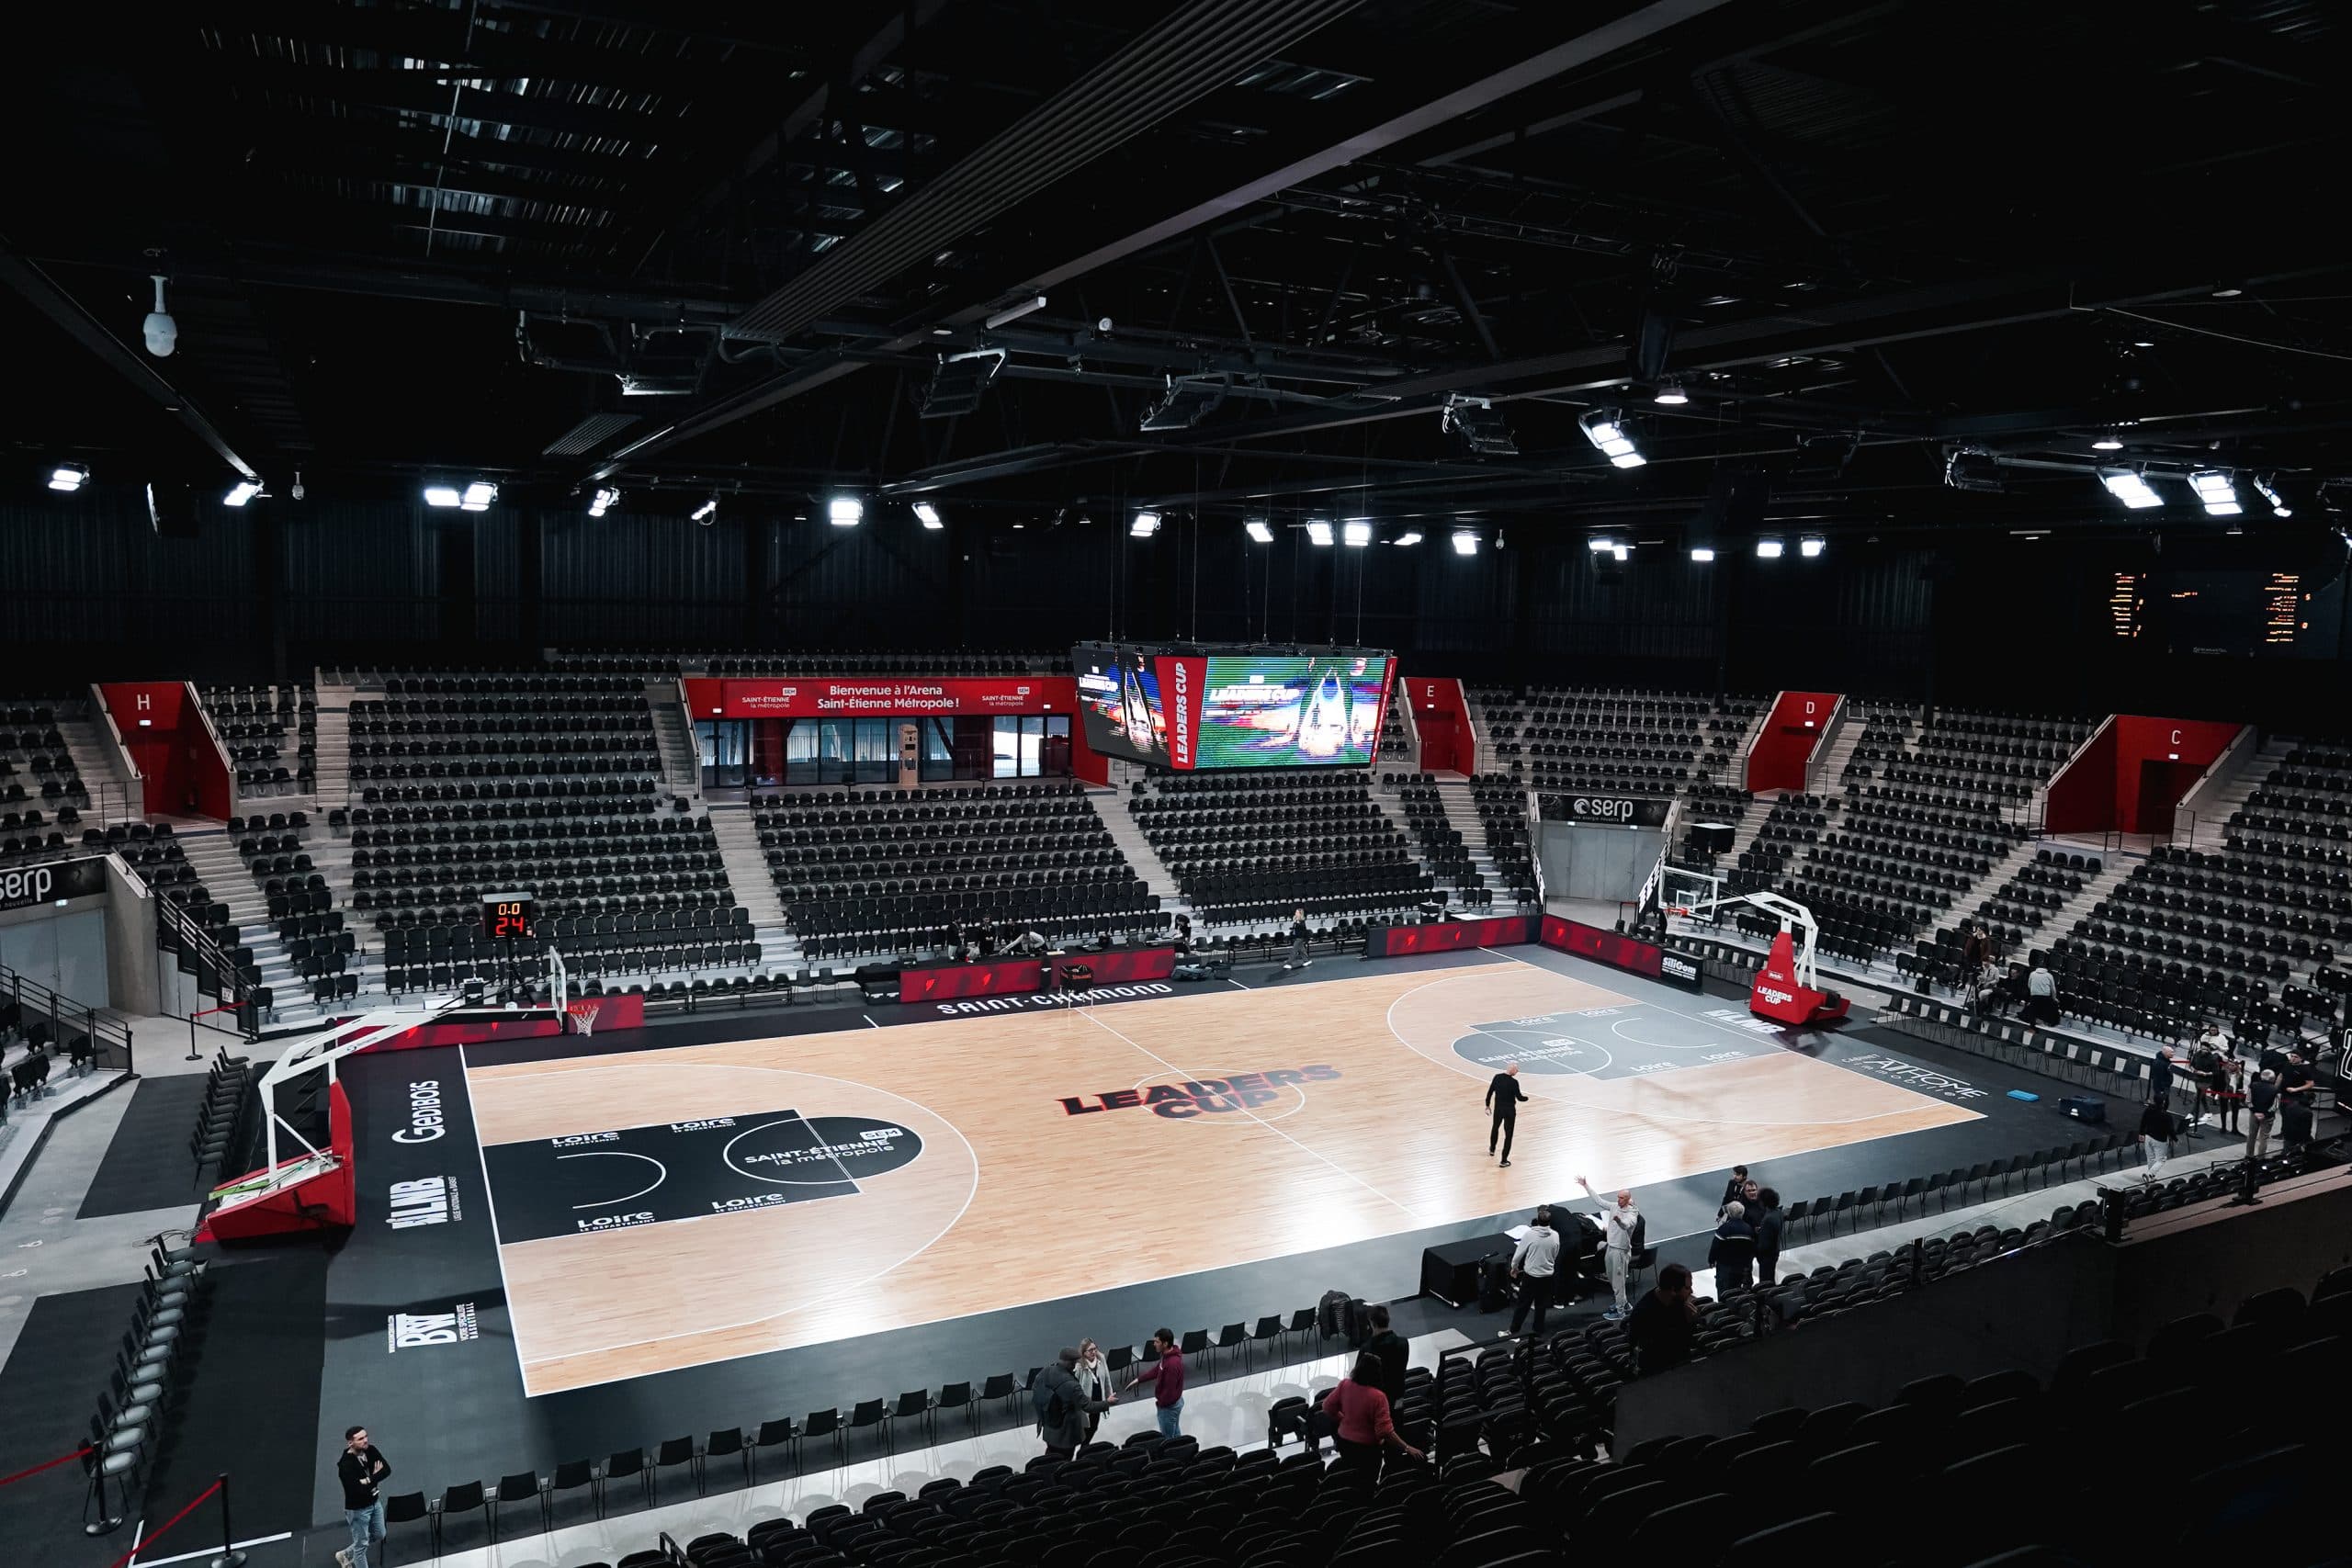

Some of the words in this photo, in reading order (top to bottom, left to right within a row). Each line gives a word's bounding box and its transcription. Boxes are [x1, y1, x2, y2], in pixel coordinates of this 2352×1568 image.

[1175, 662, 1187, 694] CUP
[830, 684, 891, 696] Bienvenue
[894, 684, 901, 695] à
[903, 684, 943, 695] l'Arena
[1427, 685, 1434, 697] E
[137, 694, 151, 710] H
[818, 695, 891, 709] Saint-Étienne
[894, 698, 955, 710] Métropole
[1805, 701, 1815, 715] D
[1176, 694, 1189, 764] LEADERS
[2171, 729, 2181, 745] C
[1590, 798, 1634, 822] serp
[0, 868, 51, 902] erp
[498, 903, 520, 916] 0.0
[495, 917, 524, 935] 24
[1757, 986, 1792, 1002] LEADERS
[1764, 995, 1781, 1006] CUP
[1055, 1065, 1343, 1116] LEADERS
[1152, 1089, 1279, 1119] CUP
[744, 1139, 889, 1164] SAINT-ÉTIENNE
[775, 1157, 793, 1167] la
